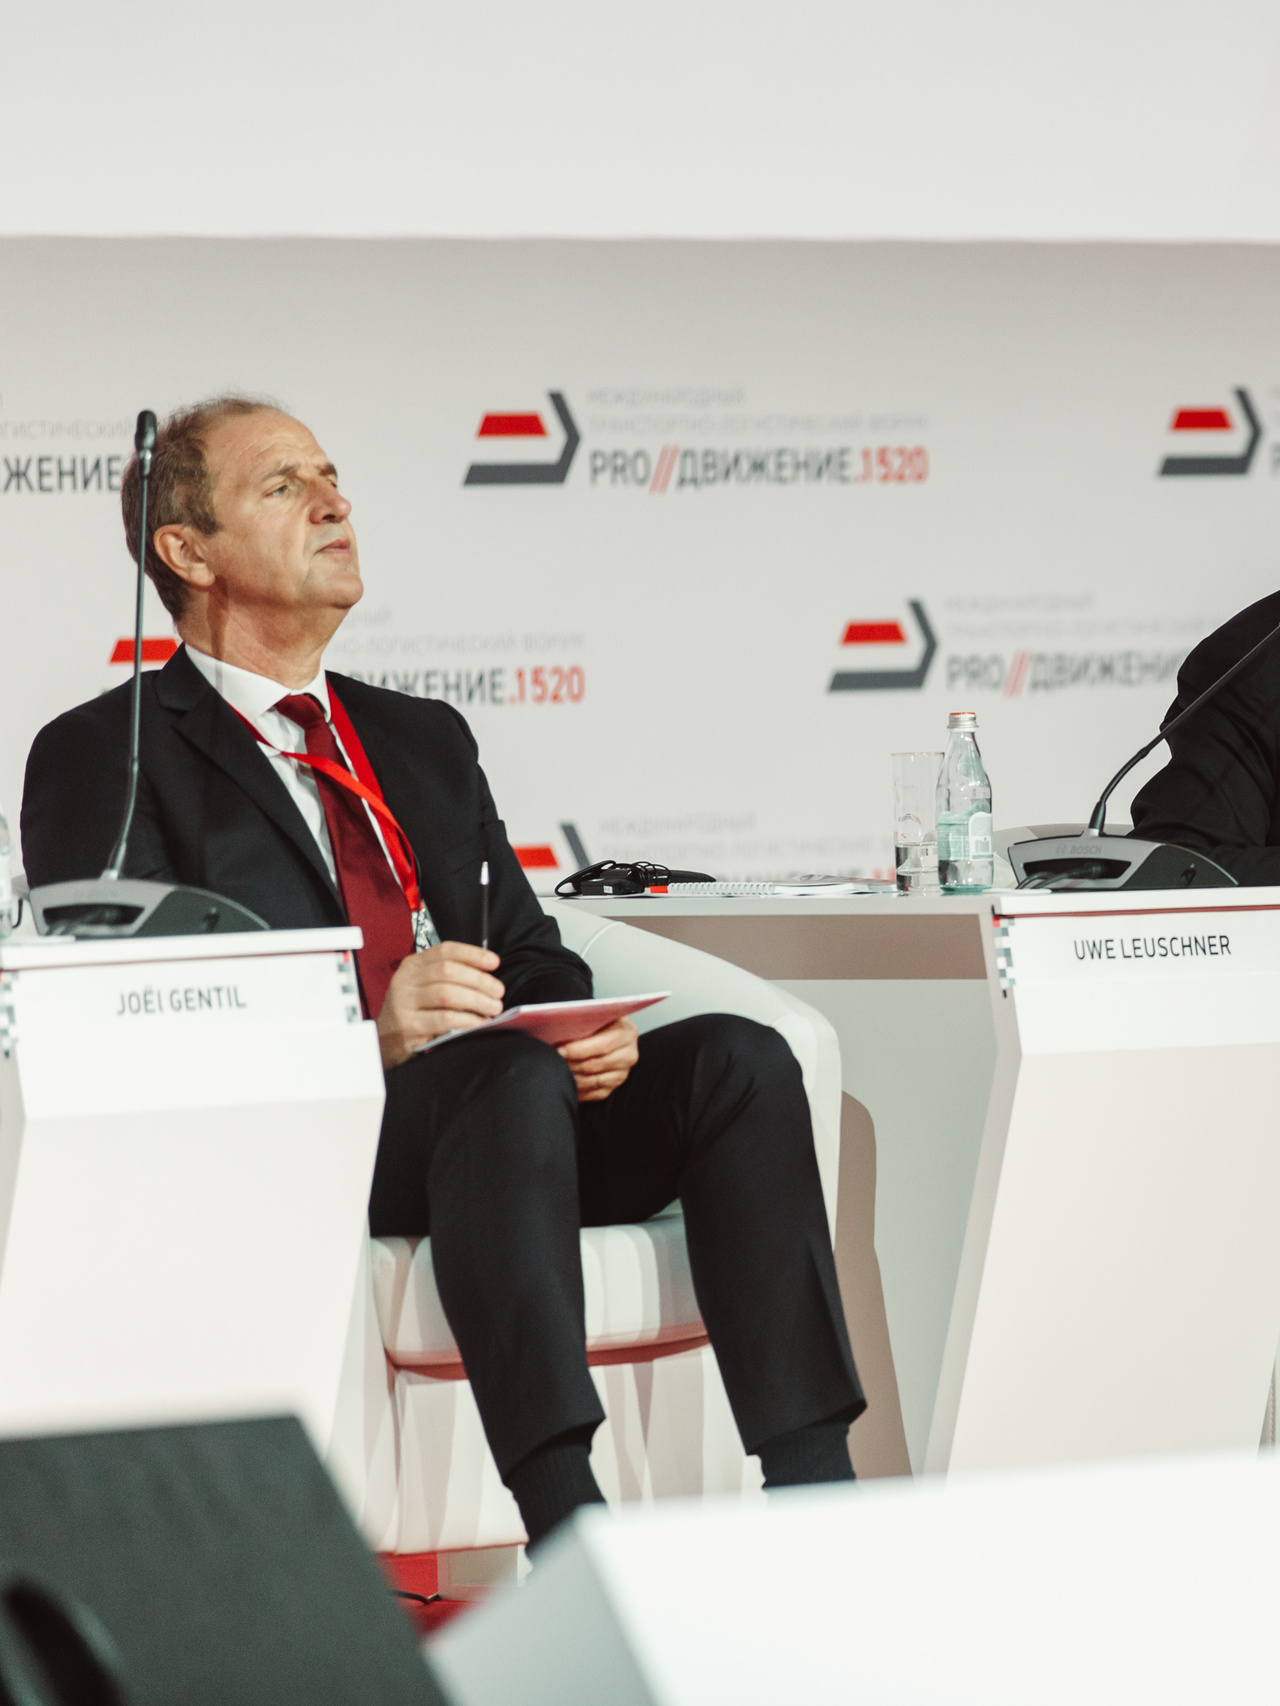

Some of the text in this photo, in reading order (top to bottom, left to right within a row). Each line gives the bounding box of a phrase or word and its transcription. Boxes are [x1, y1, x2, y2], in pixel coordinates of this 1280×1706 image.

[1073, 935, 1231, 960] UWE LEUSCHNER
[169, 986, 248, 1012] GENTIL
